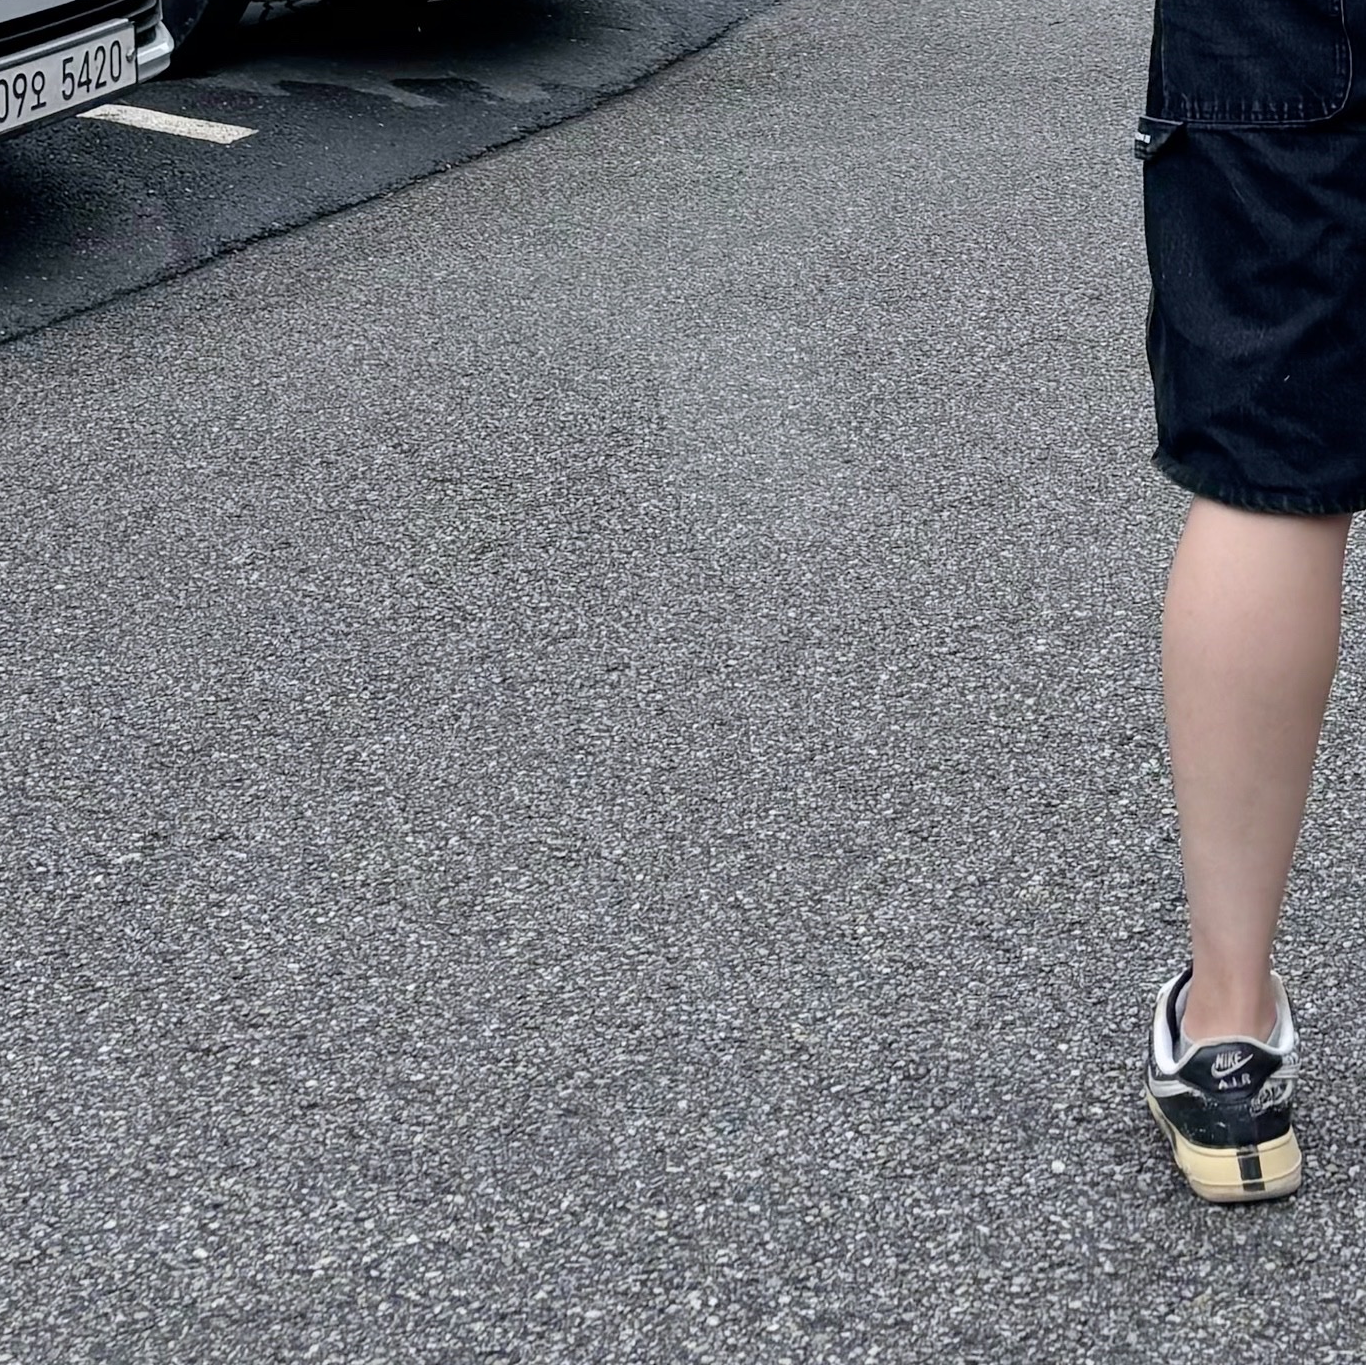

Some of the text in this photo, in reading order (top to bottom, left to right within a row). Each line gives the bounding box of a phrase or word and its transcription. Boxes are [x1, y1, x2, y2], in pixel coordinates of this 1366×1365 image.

[61, 39, 123, 102] 5420
[1214, 1050, 1243, 1069] NIKE
[1217, 1072, 1252, 1091] AIR
